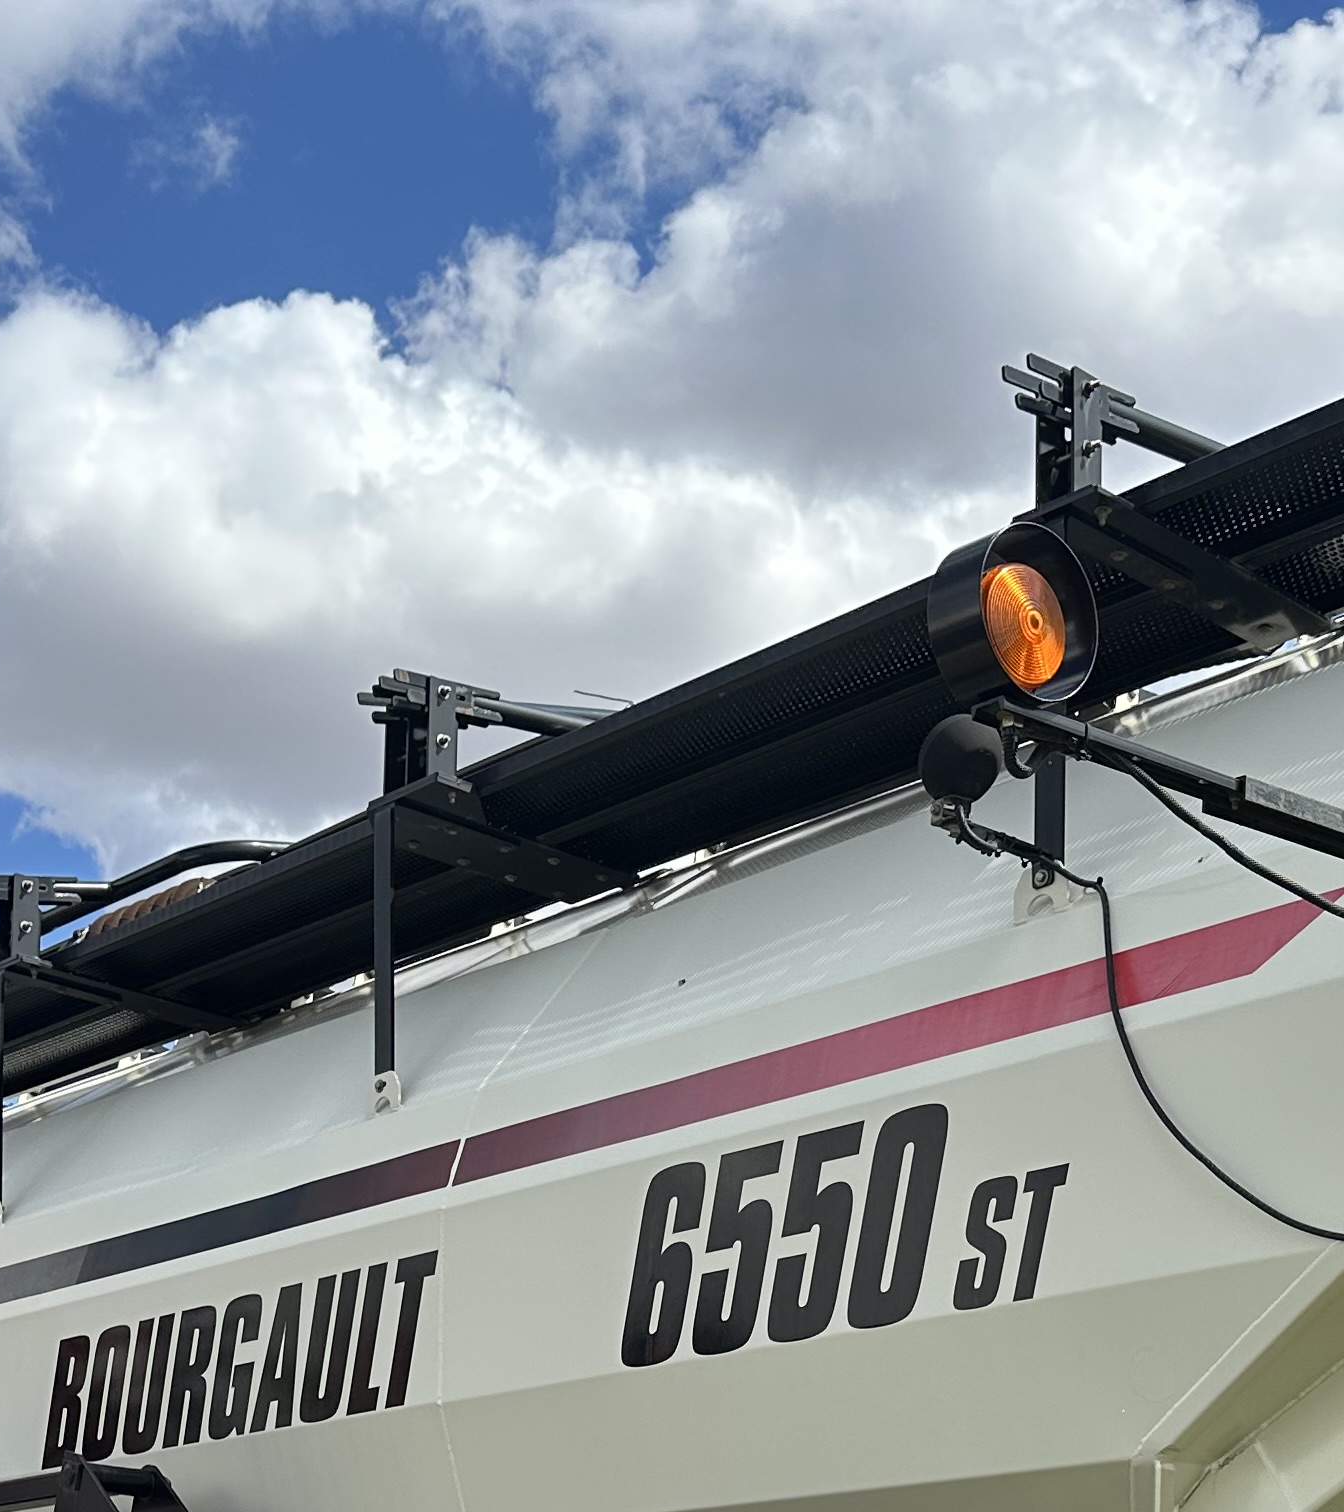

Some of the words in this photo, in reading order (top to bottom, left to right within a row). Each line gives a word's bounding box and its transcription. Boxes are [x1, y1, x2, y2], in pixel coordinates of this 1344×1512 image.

[42, 1249, 438, 1470] BOURGAULT
[620, 1103, 948, 1368] 6550
[951, 1162, 1070, 1311] ST
